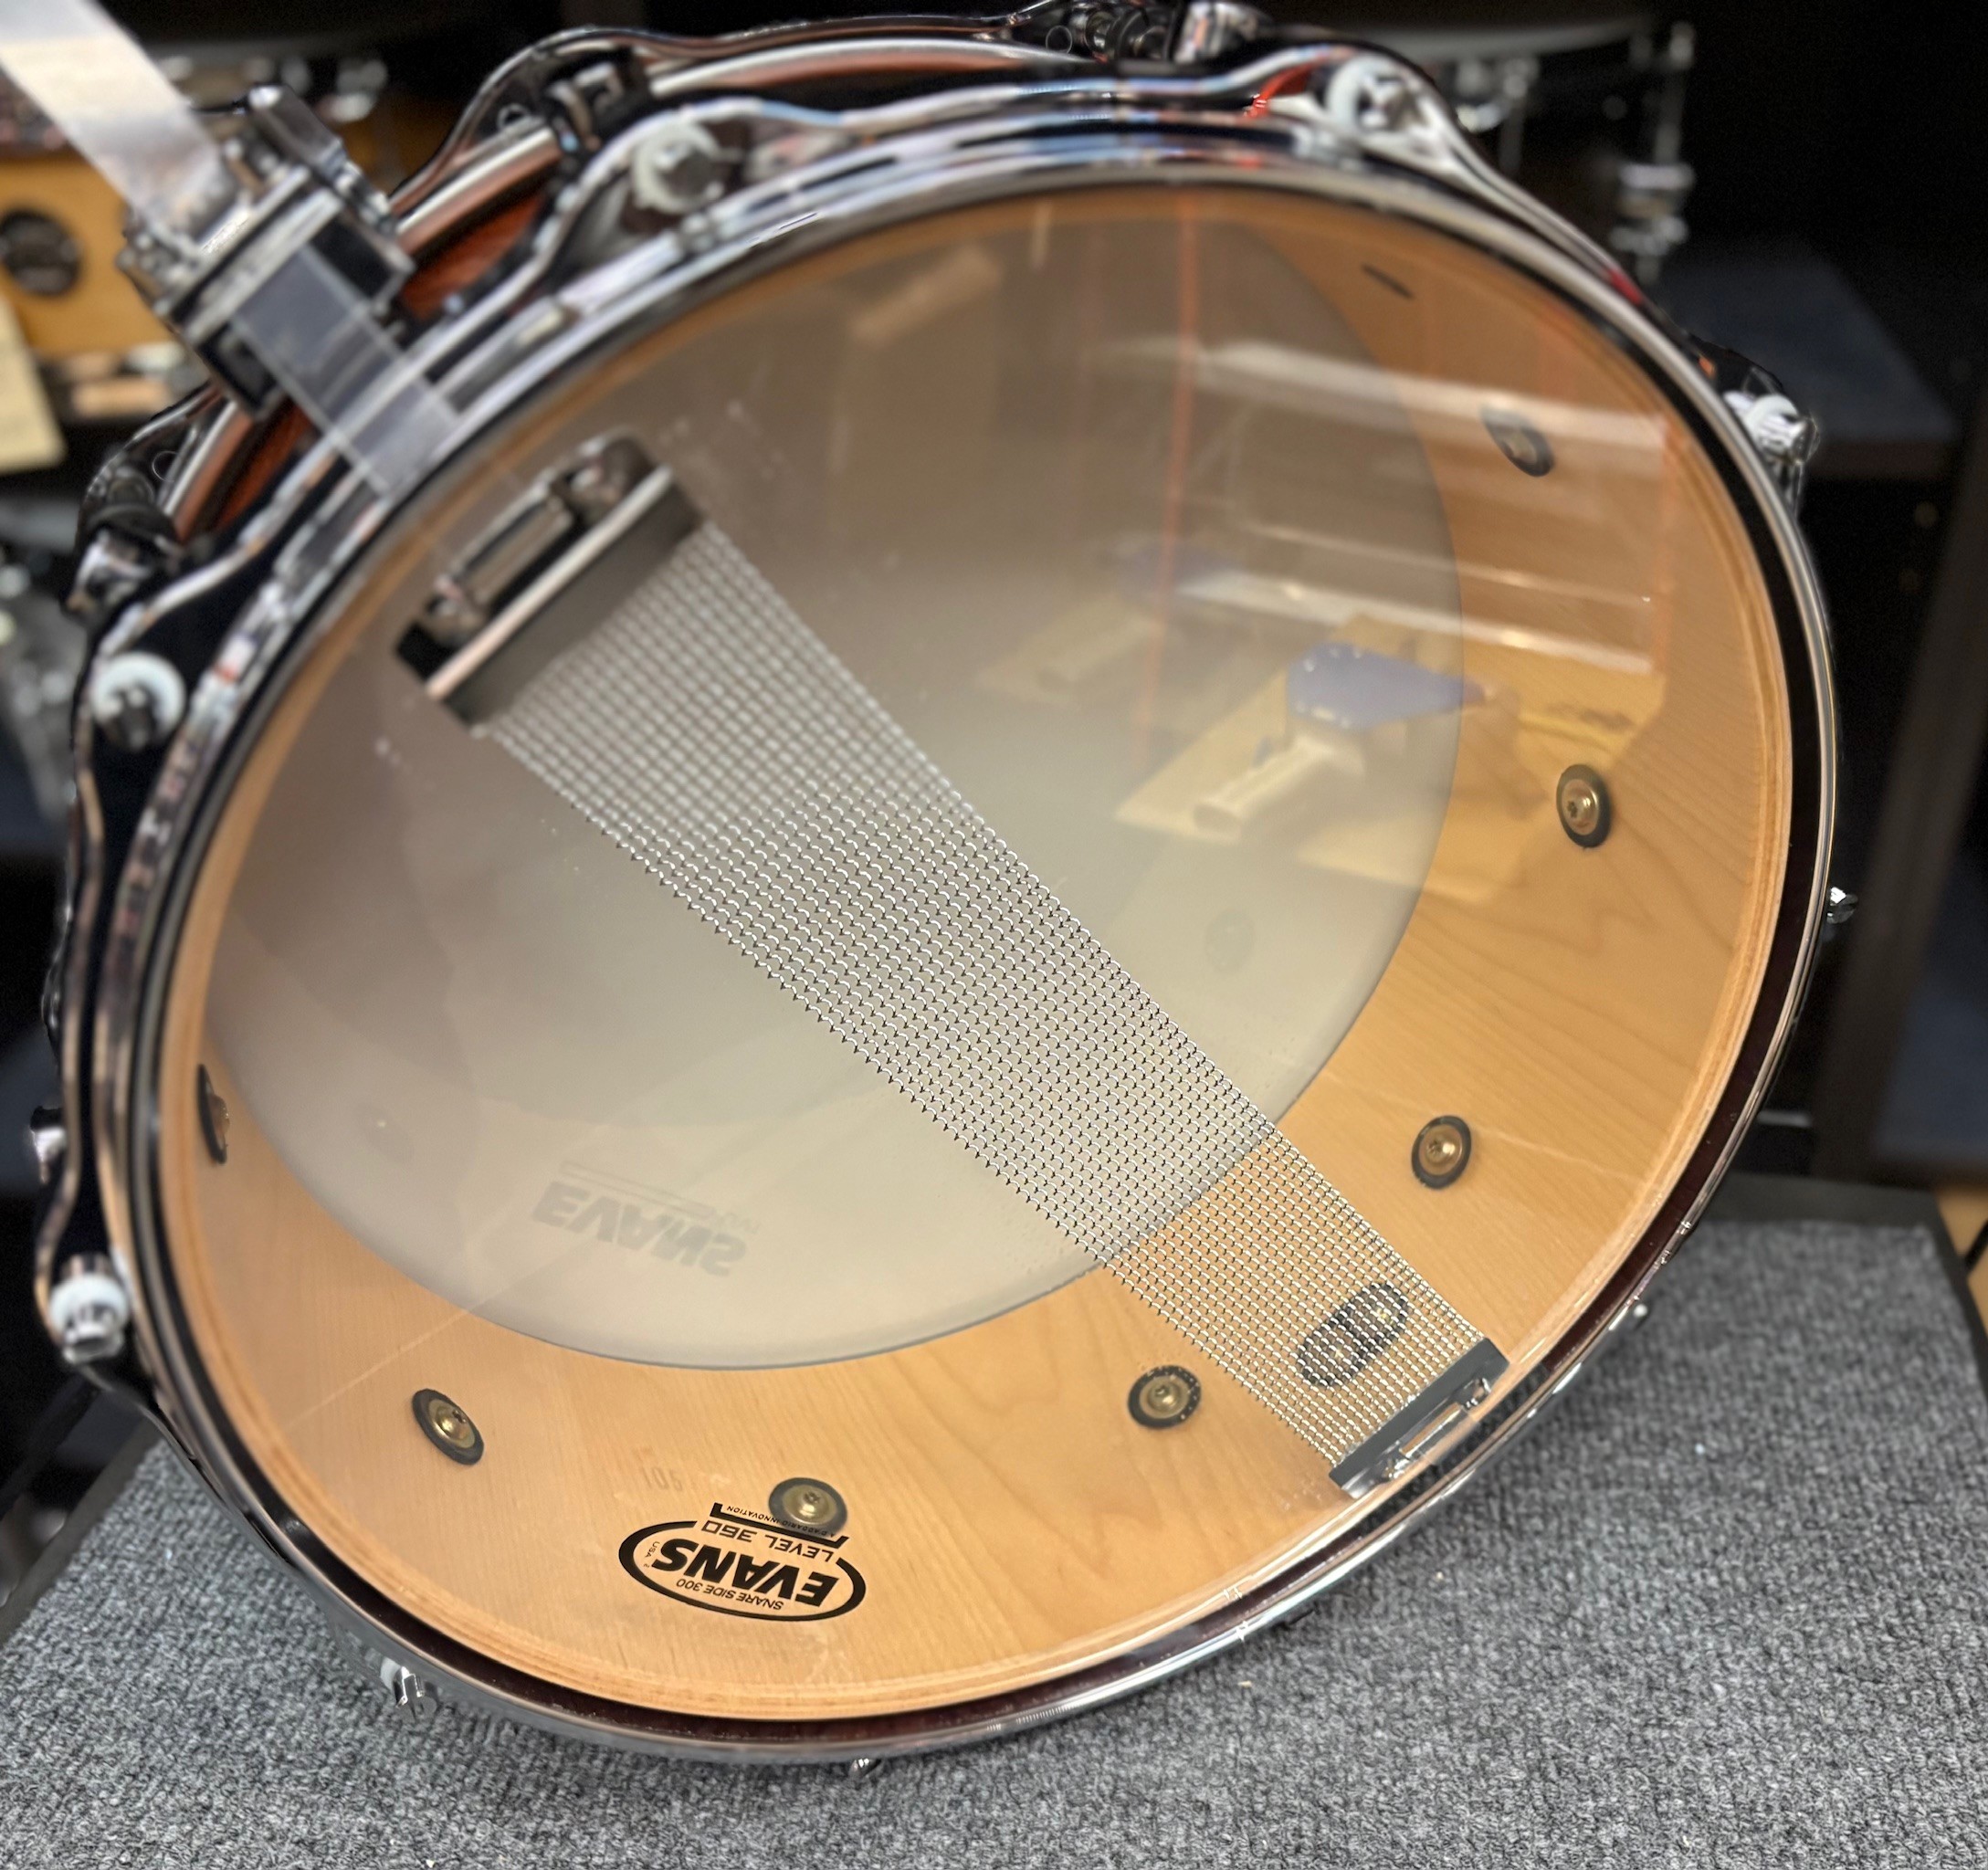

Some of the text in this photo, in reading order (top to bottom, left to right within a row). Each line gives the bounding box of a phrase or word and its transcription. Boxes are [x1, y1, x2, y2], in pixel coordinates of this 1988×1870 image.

[727, 1505, 778, 1523] INNOVATION
[645, 1541, 660, 1558] USA
[701, 1519, 835, 1562] LEVEL 360
[652, 1539, 840, 1607] EVANS
[676, 1578, 784, 1611] SNARE SIDE 300
